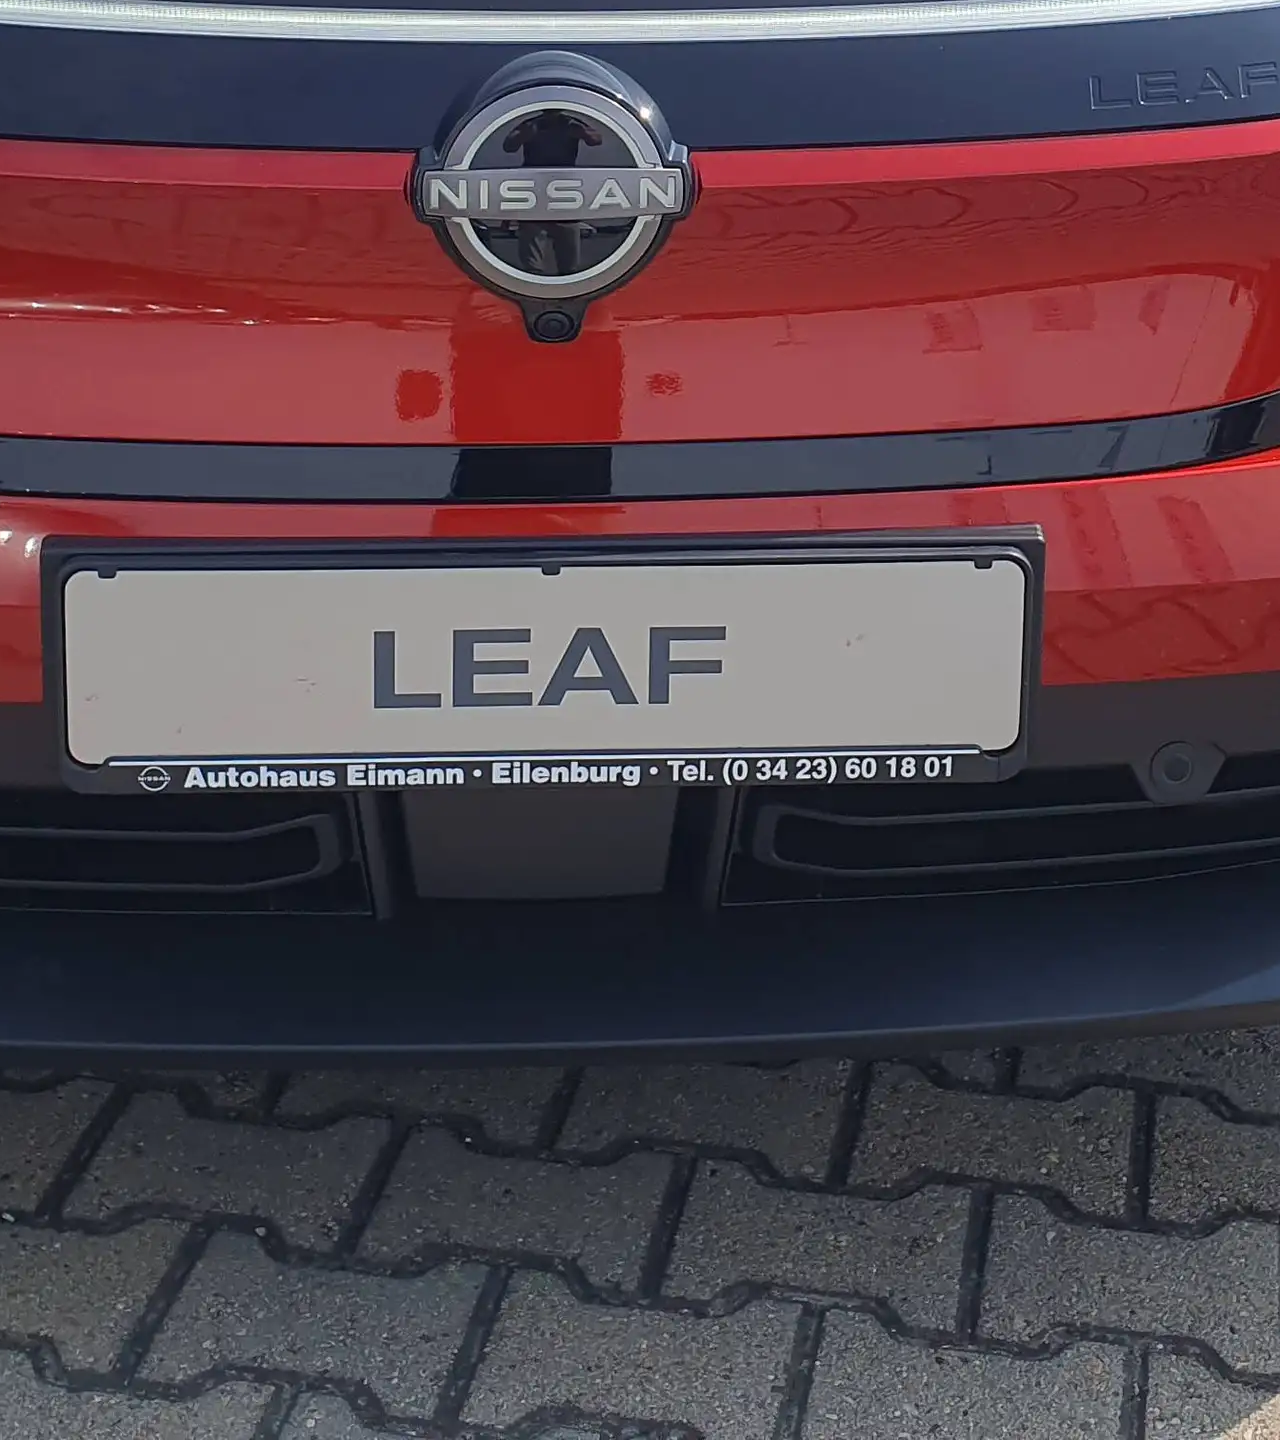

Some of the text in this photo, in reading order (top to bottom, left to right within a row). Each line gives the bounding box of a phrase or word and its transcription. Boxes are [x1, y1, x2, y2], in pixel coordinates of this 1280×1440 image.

[1088, 60, 1280, 110] LEAF
[428, 176, 677, 210] NISSAN
[374, 626, 726, 708] LEAF
[184, 755, 953, 788] Autohaus Eimann Eilenburg Tel. (0 34 23) 60 18 01
